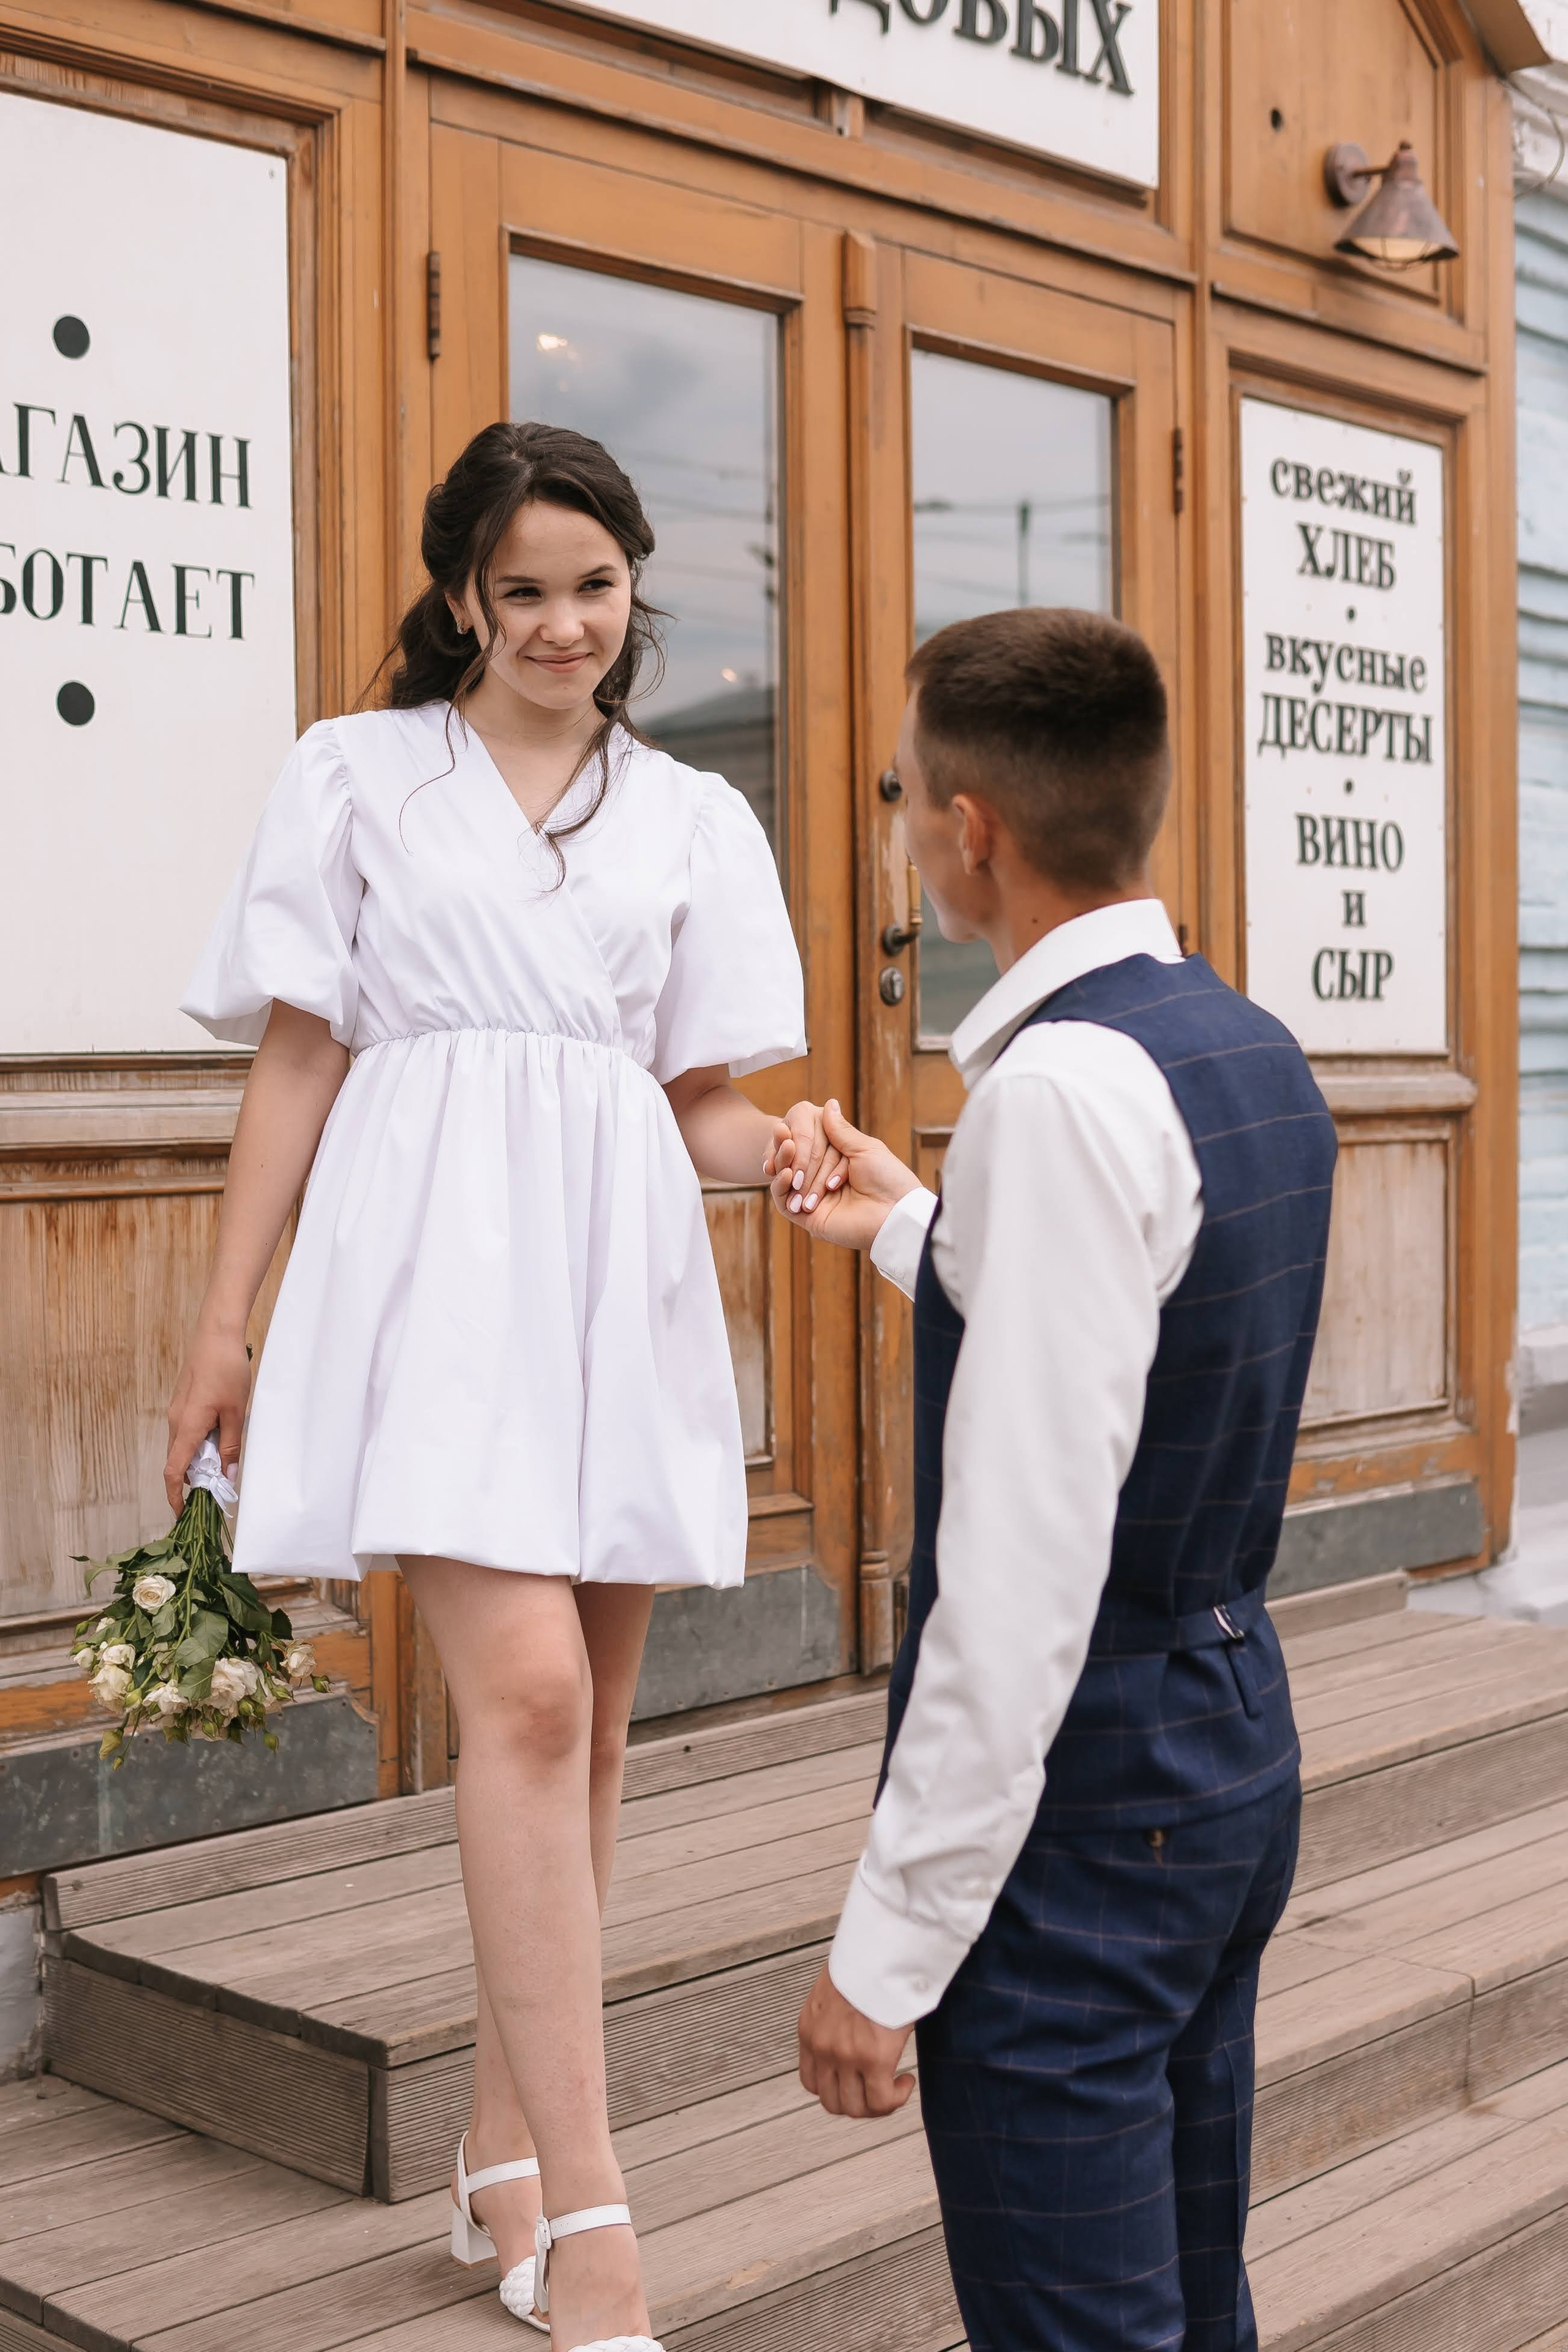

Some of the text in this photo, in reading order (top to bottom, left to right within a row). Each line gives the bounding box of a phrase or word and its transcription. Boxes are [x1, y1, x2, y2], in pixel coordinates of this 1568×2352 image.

[828, 0, 1134, 97] ВЫХ
[0, 402, 252, 509] ГАЗИН
[1270, 459, 1416, 525] свежий
[1297, 522, 1395, 589] ХЛЕБ
[1265, 633, 1427, 694] вкусные
[1258, 693, 1433, 764] ДЕСЕРТЫ
[1295, 813, 1404, 871] ВИНО
[1342, 891, 1365, 927] и
[1312, 948, 1393, 1000] СЫР
